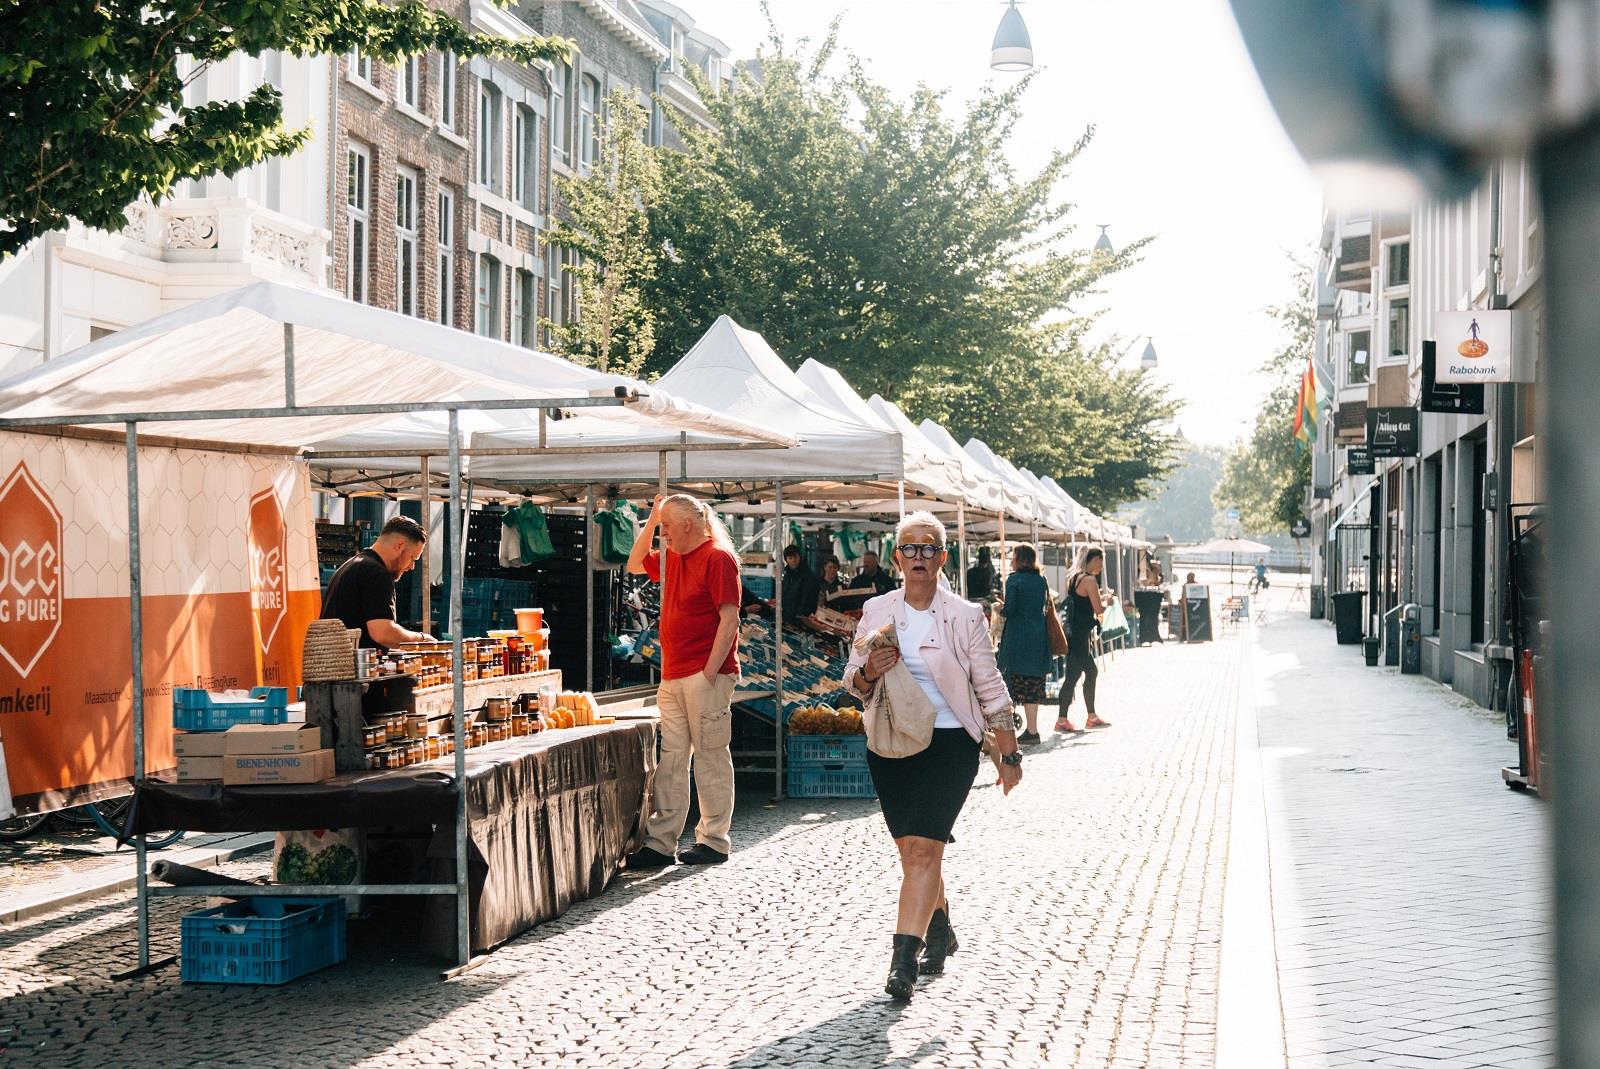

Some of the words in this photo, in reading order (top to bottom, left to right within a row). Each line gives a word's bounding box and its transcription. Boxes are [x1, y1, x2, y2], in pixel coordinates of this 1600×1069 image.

[1449, 365, 1497, 375] Rabobank
[260, 592, 281, 609] PURE
[16, 598, 57, 622] PURE
[236, 757, 301, 769] BIENENHONIG
